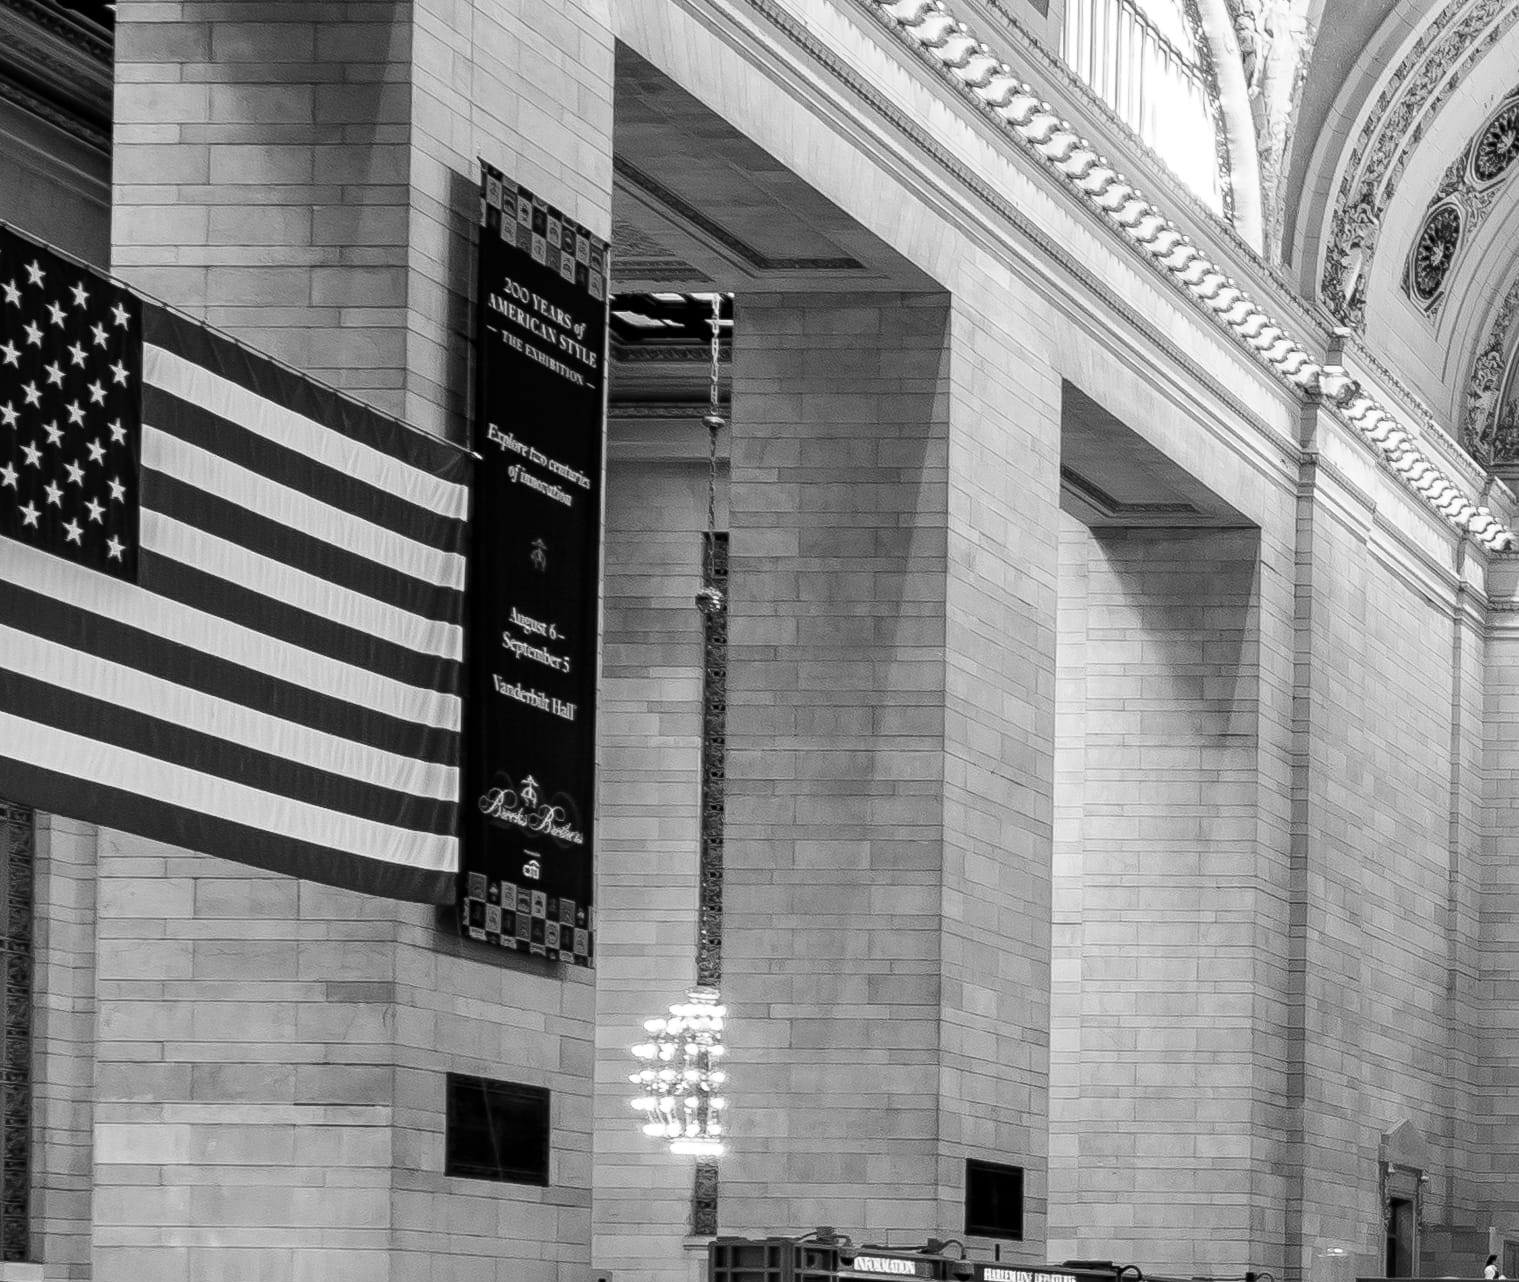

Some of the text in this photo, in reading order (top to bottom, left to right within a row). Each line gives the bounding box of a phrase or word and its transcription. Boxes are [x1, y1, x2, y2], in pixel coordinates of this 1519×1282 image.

[488, 293, 597, 368] AMERICAN STYLE
[504, 277, 587, 340] 200 YEARS of
[502, 330, 584, 386] THE EXHIBITION
[487, 422, 529, 457] Explore
[508, 606, 547, 636] August
[502, 631, 562, 670] September
[492, 673, 577, 720] Vanderbilt Hall
